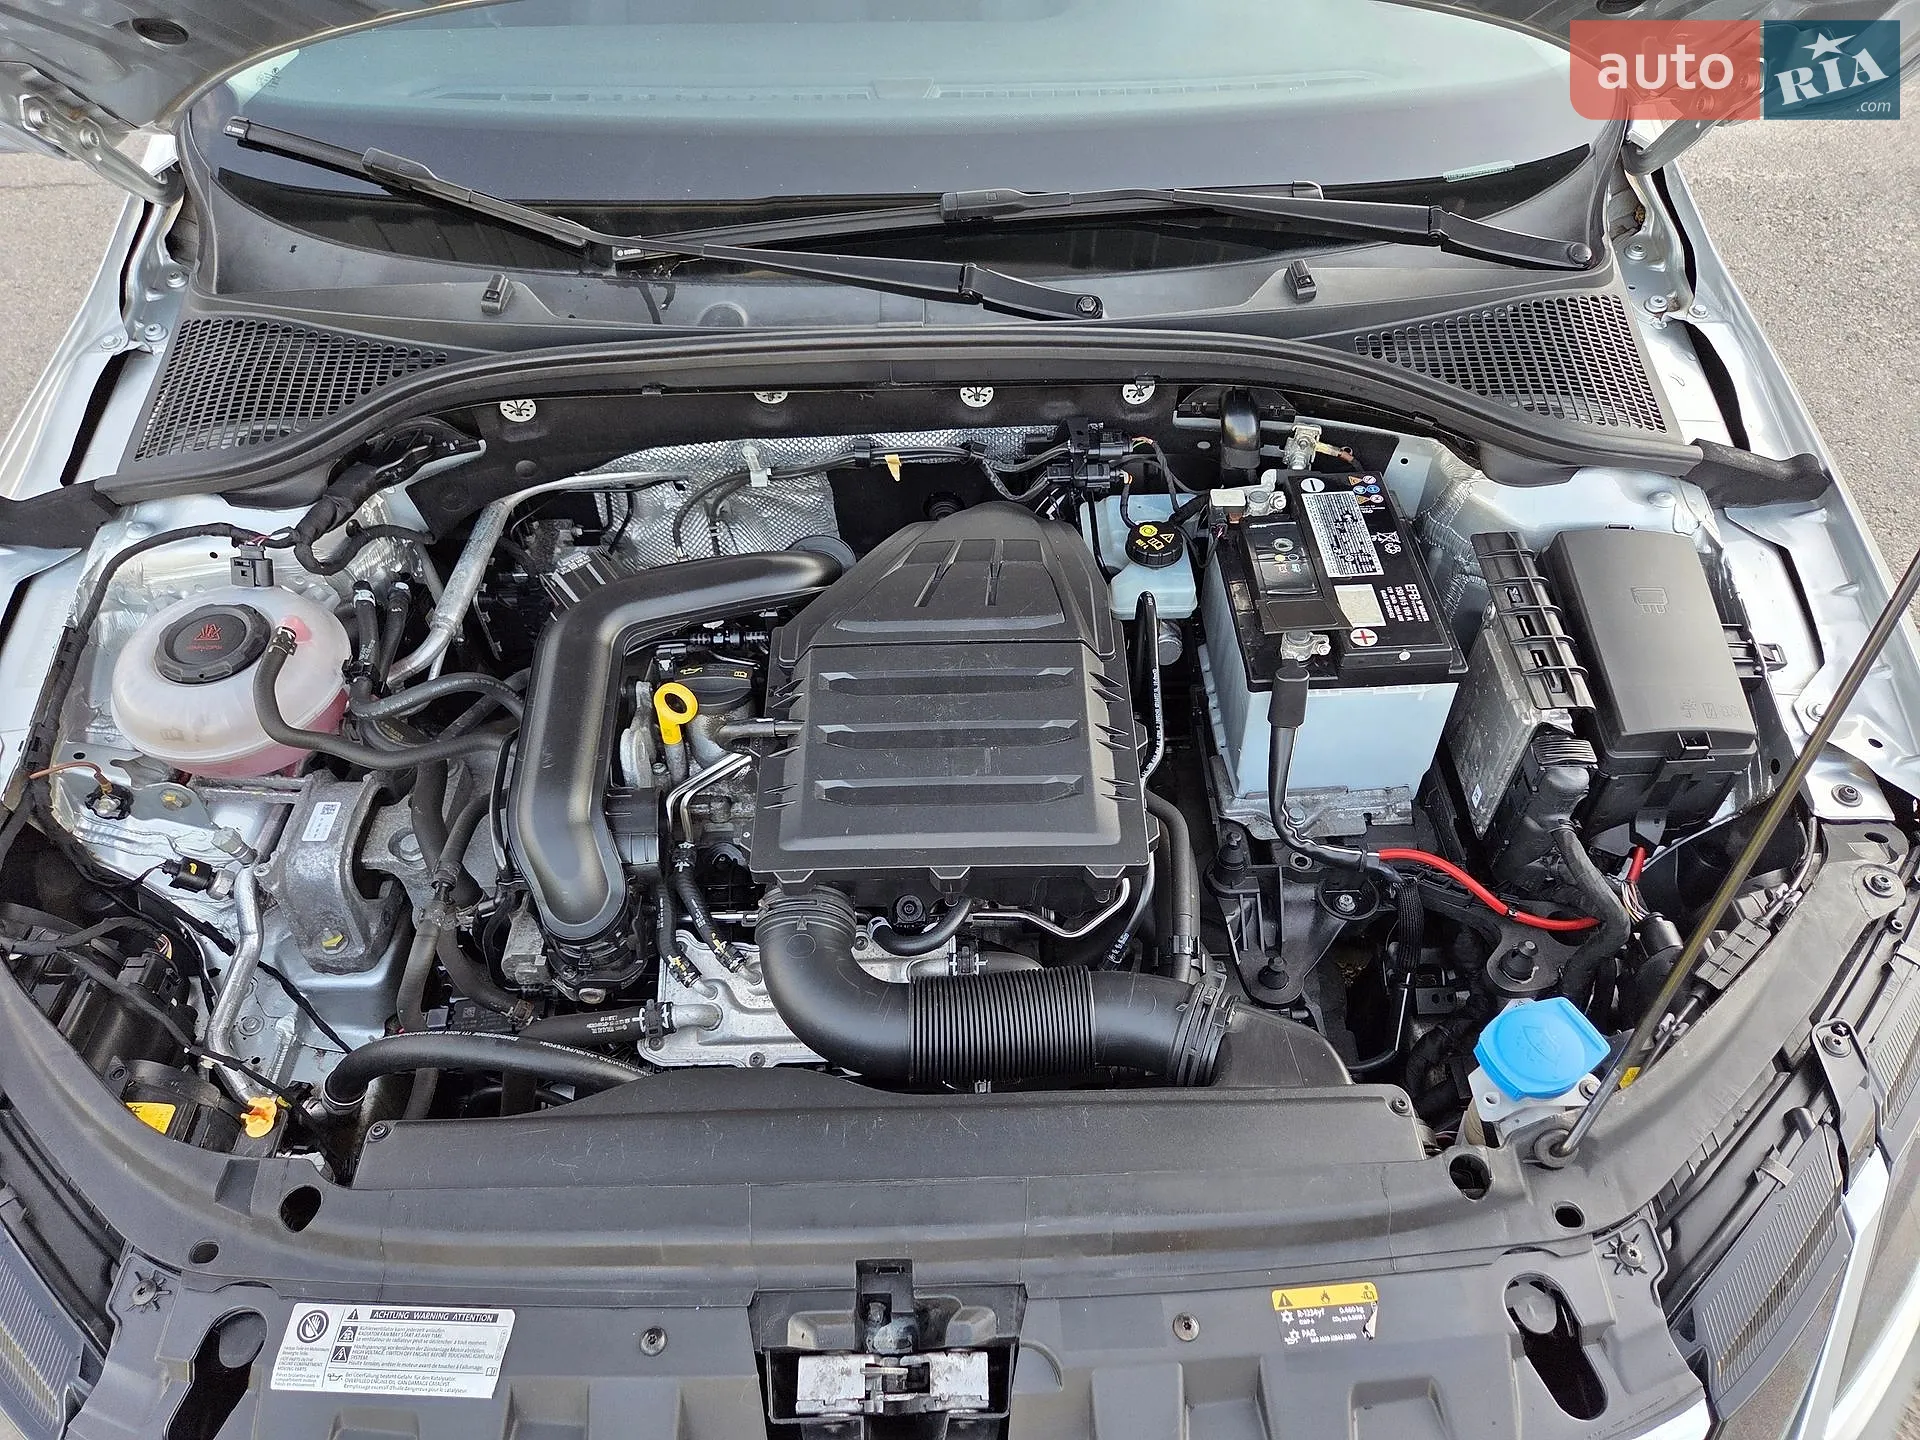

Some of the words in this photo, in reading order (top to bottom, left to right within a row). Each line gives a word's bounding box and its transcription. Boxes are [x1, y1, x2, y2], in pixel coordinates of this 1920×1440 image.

[1404, 584, 1420, 600] EFB
[373, 1310, 409, 1319] ACHTUNG
[412, 1311, 449, 1320] WARNING
[451, 1312, 494, 1321] ATTENTION
[1301, 1329, 1316, 1337] PAG
